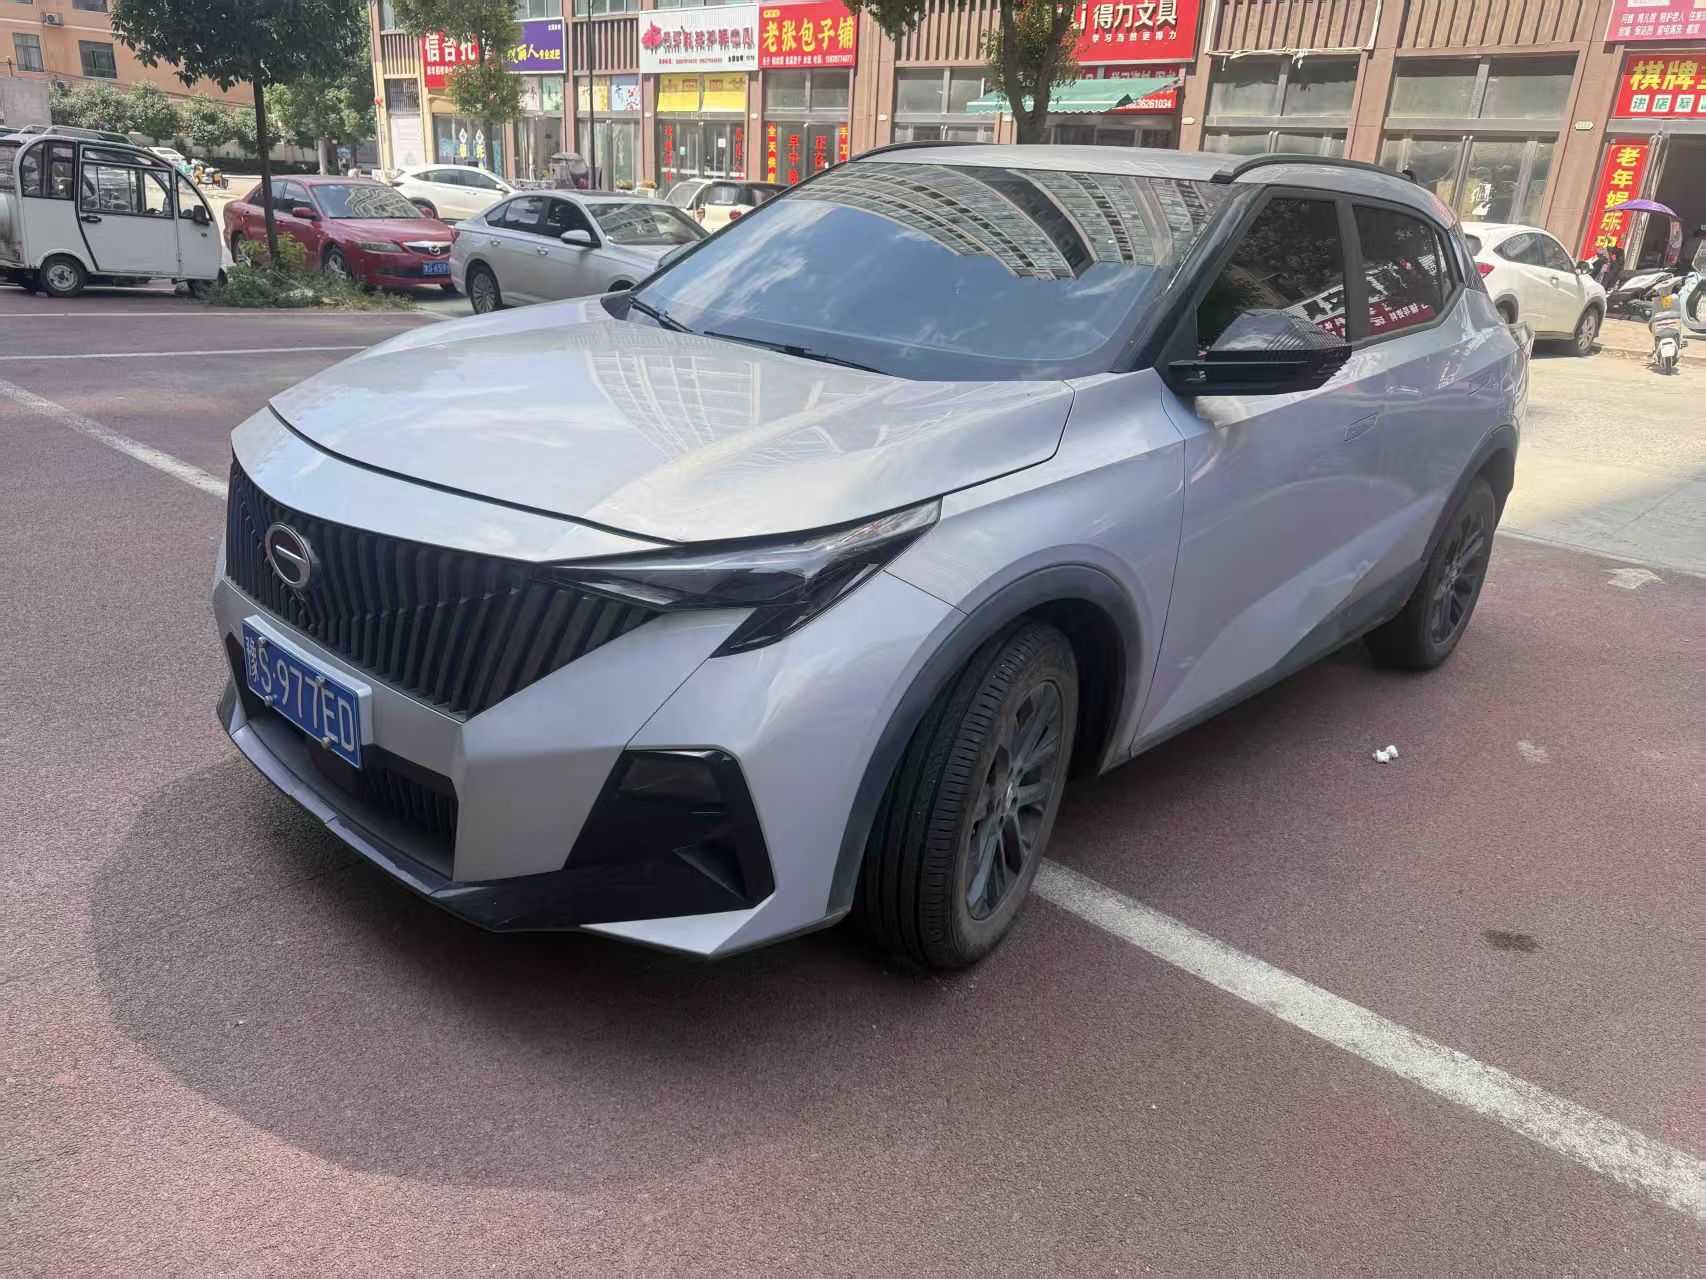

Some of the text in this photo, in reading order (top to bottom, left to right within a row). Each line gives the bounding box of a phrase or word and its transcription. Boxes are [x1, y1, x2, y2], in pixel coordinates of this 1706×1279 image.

[1093, 0, 1177, 29] 得力文具
[762, 17, 854, 53] 老张包子铺
[1091, 31, 1177, 43] 学习当然更得力
[814, 136, 827, 174] 正在
